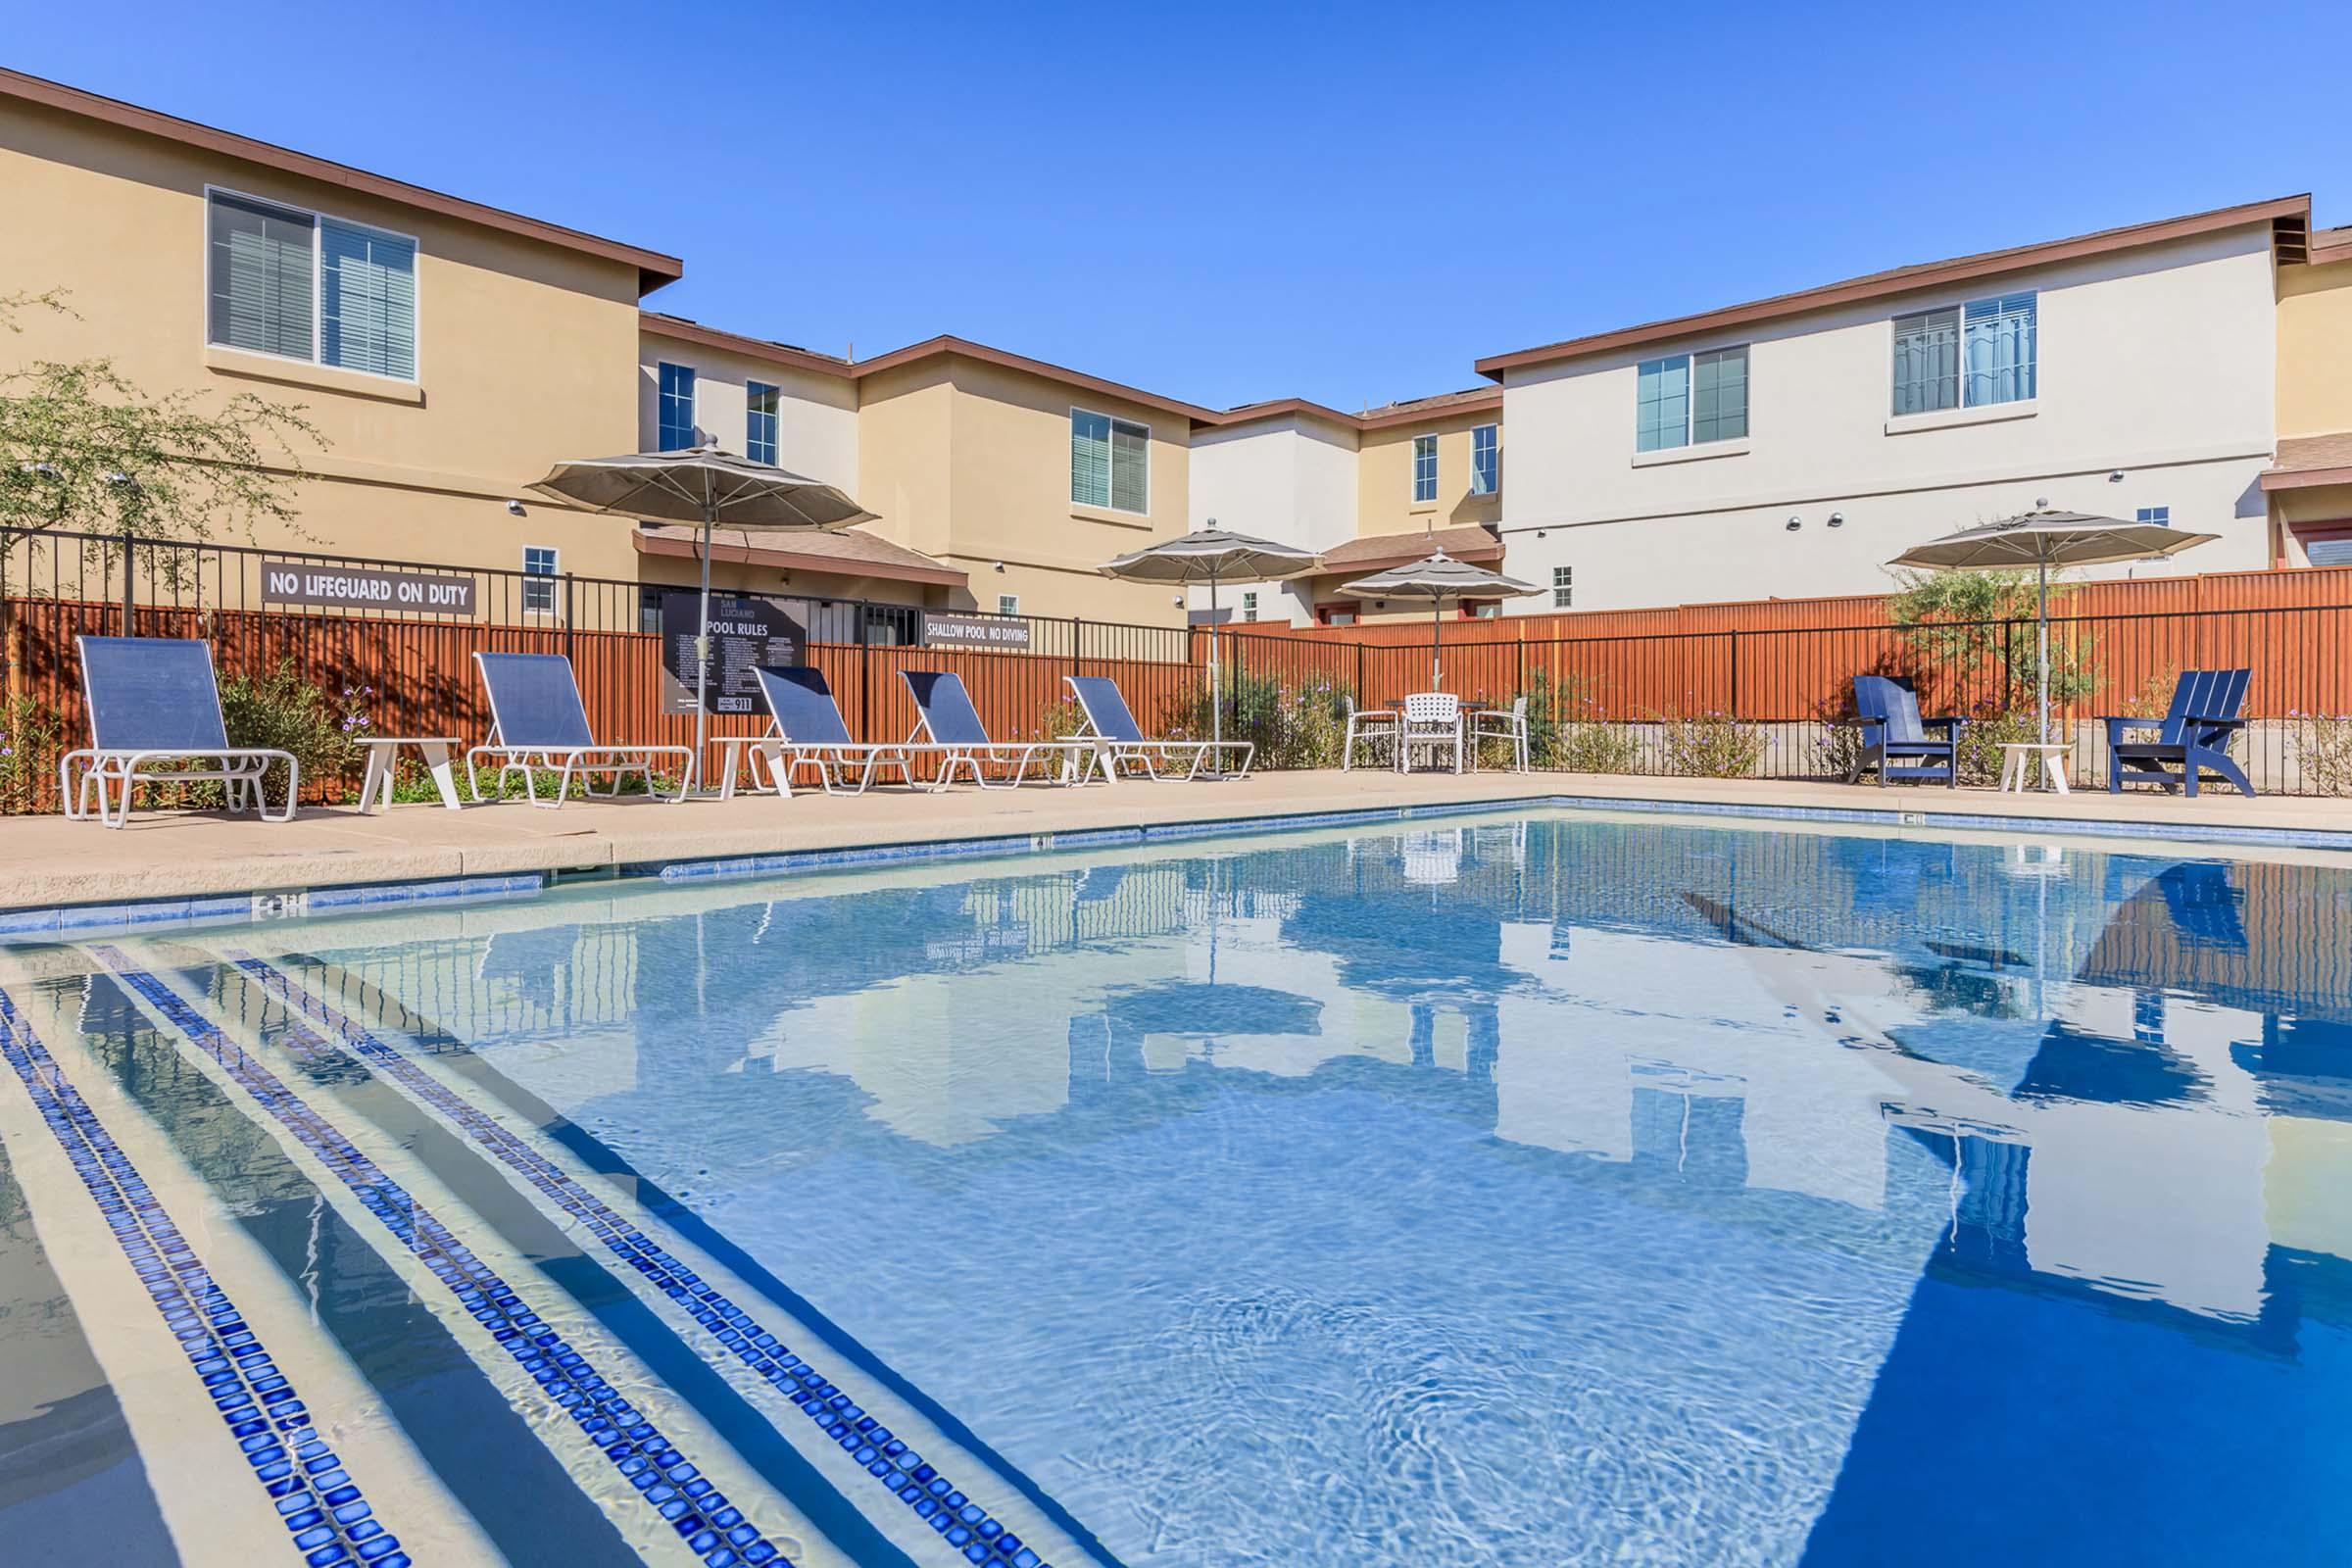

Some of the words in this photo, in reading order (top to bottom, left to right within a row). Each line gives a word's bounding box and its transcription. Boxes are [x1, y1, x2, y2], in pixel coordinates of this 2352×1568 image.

[270, 571, 298, 594] NO
[306, 574, 391, 601] LIFEGUARD
[398, 581, 423, 603] ON
[429, 584, 468, 606] DUTY
[707, 621, 735, 634] POOL
[737, 622, 768, 636] RULES
[927, 622, 964, 638] SHALLOW
[965, 625, 986, 640] POOL
[989, 627, 1001, 640] NO
[1003, 628, 1028, 642] DIVING
[735, 698, 751, 710] 911
